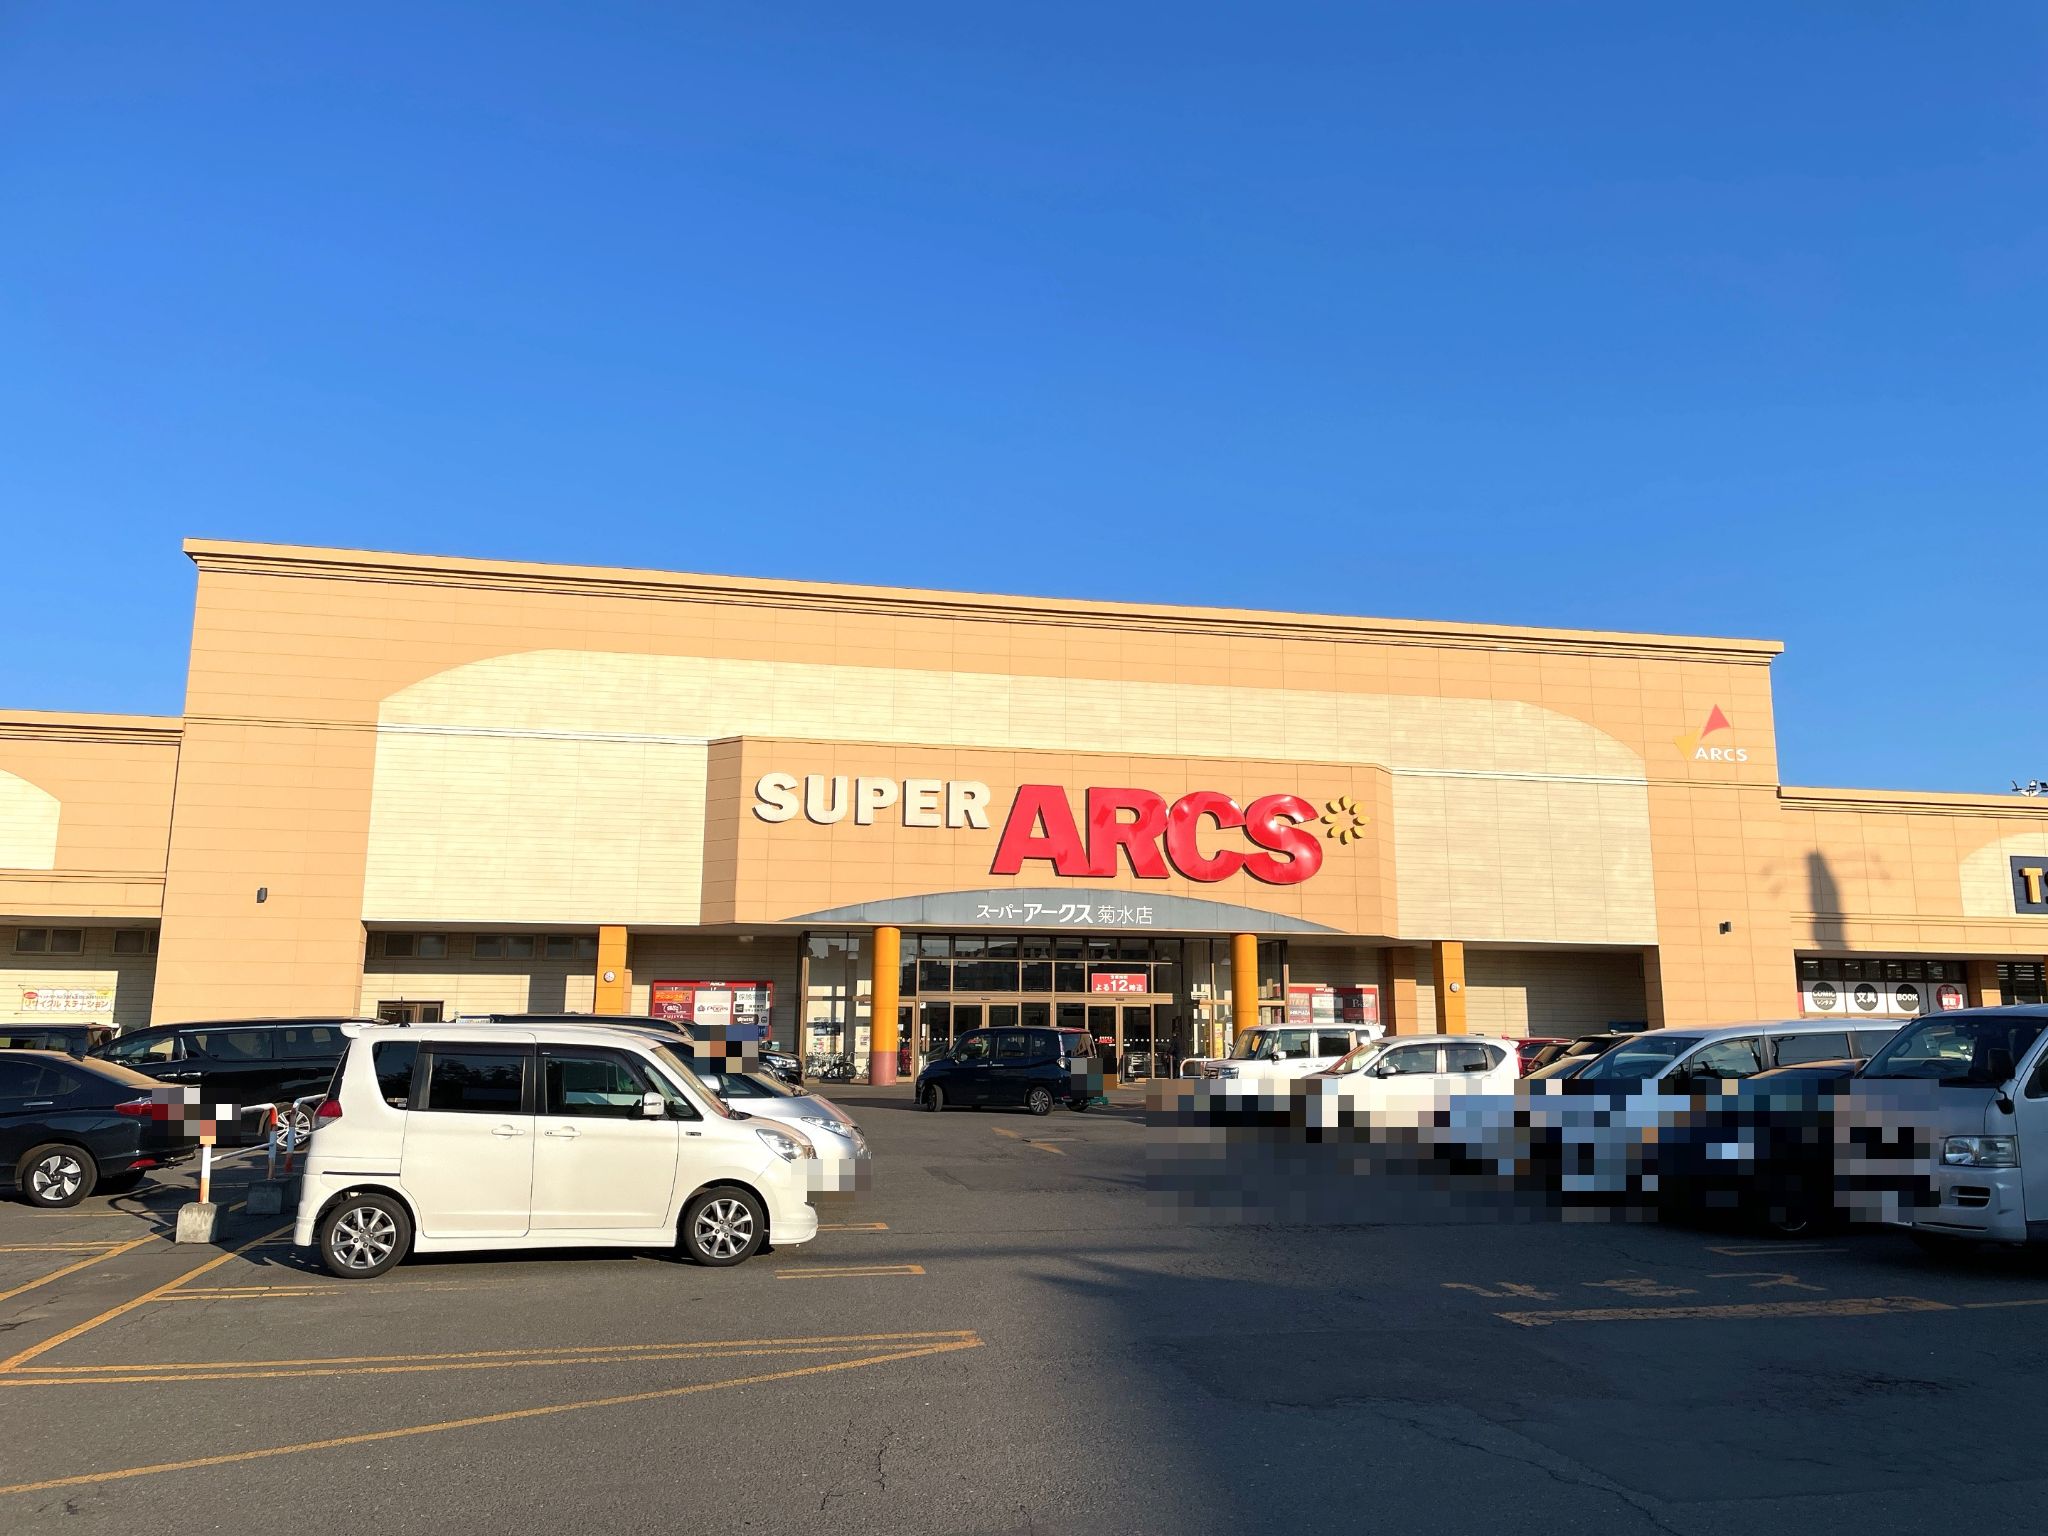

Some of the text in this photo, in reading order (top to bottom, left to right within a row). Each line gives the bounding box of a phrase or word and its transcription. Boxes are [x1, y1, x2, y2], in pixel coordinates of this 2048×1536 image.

[1695, 747, 1748, 761] ARCS
[753, 772, 1324, 885] SUPER ARCS
[977, 903, 1153, 924] スーパーアークス 菊水店
[1857, 992, 1877, 1003] 文具
[1897, 993, 1919, 1001] BOOK
[25, 1000, 109, 1009] リサイクル ステーション
